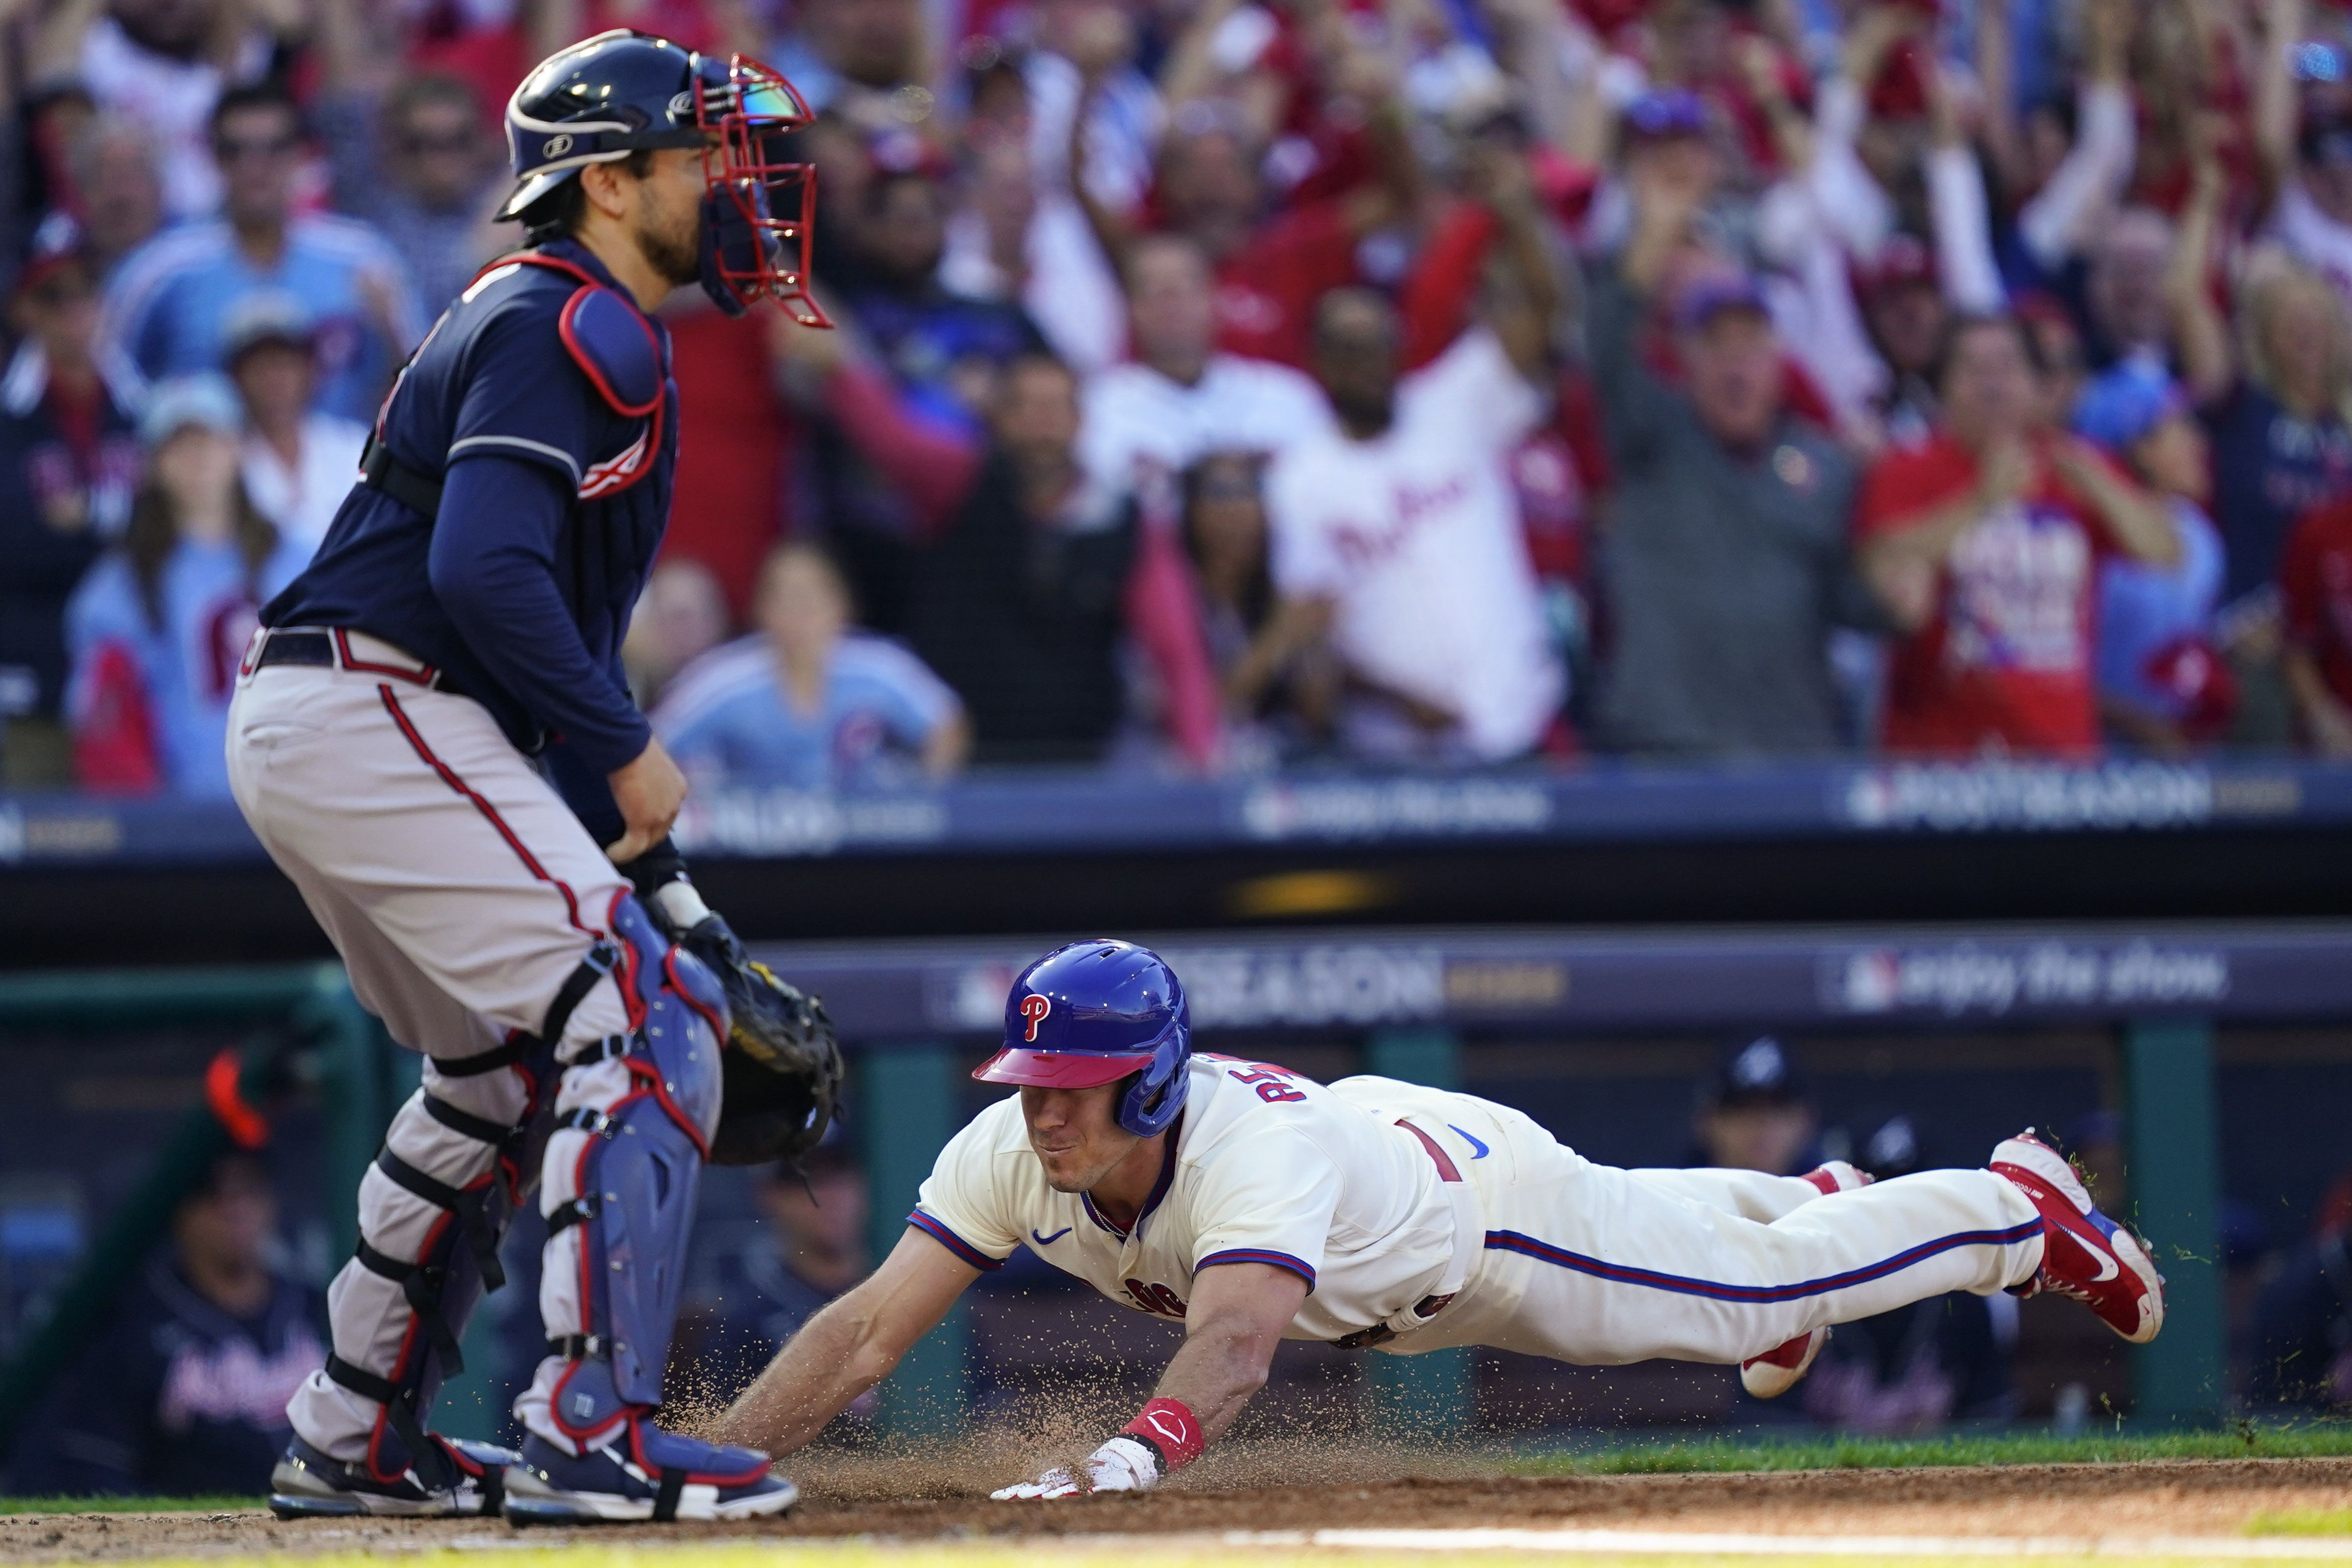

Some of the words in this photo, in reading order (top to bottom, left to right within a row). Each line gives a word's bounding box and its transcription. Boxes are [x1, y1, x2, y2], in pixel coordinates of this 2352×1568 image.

[1895, 765, 2209, 828] POSTSEASON
[2028, 941, 2098, 1002] the
[1020, 993, 1051, 1042] P
